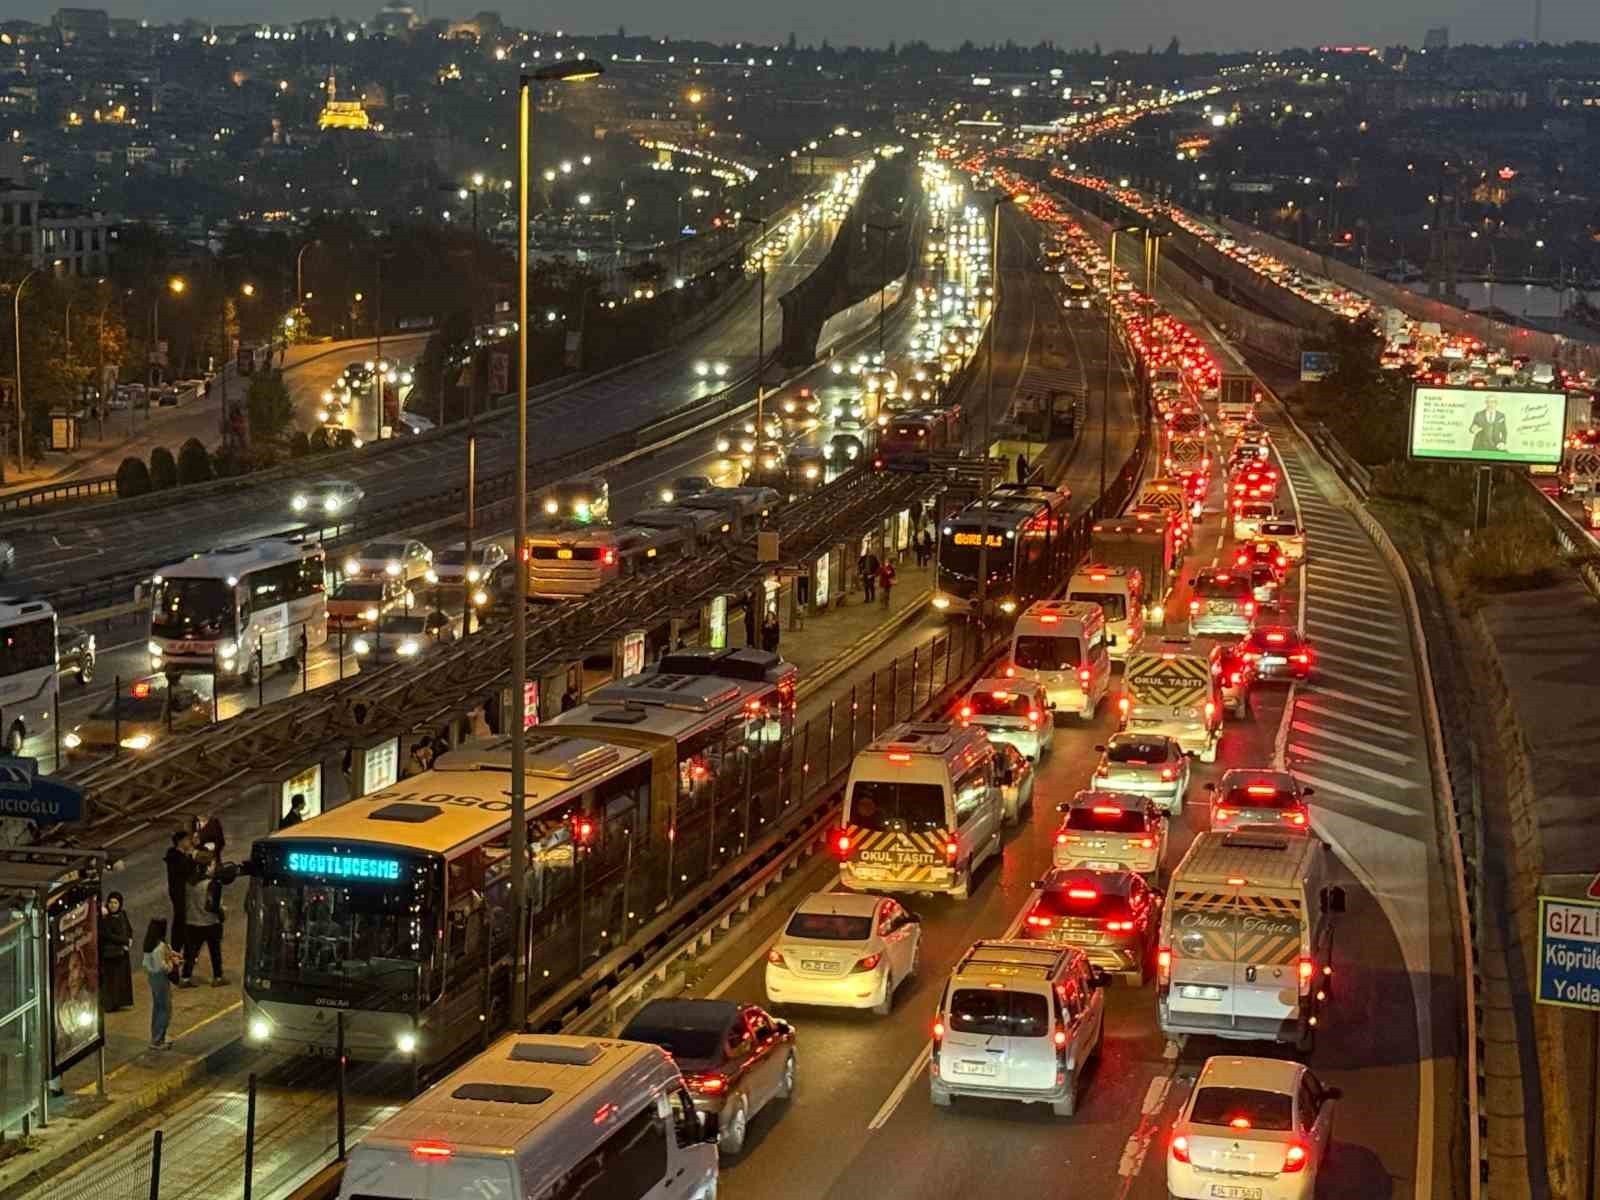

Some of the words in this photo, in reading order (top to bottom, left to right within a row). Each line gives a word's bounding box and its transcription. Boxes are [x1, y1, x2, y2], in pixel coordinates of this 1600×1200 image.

[861, 850, 892, 862] OKUL
[1181, 913, 1227, 928] Okul
[1549, 909, 1600, 937] GİZLİ
[1553, 978, 1600, 1004] Yolda
